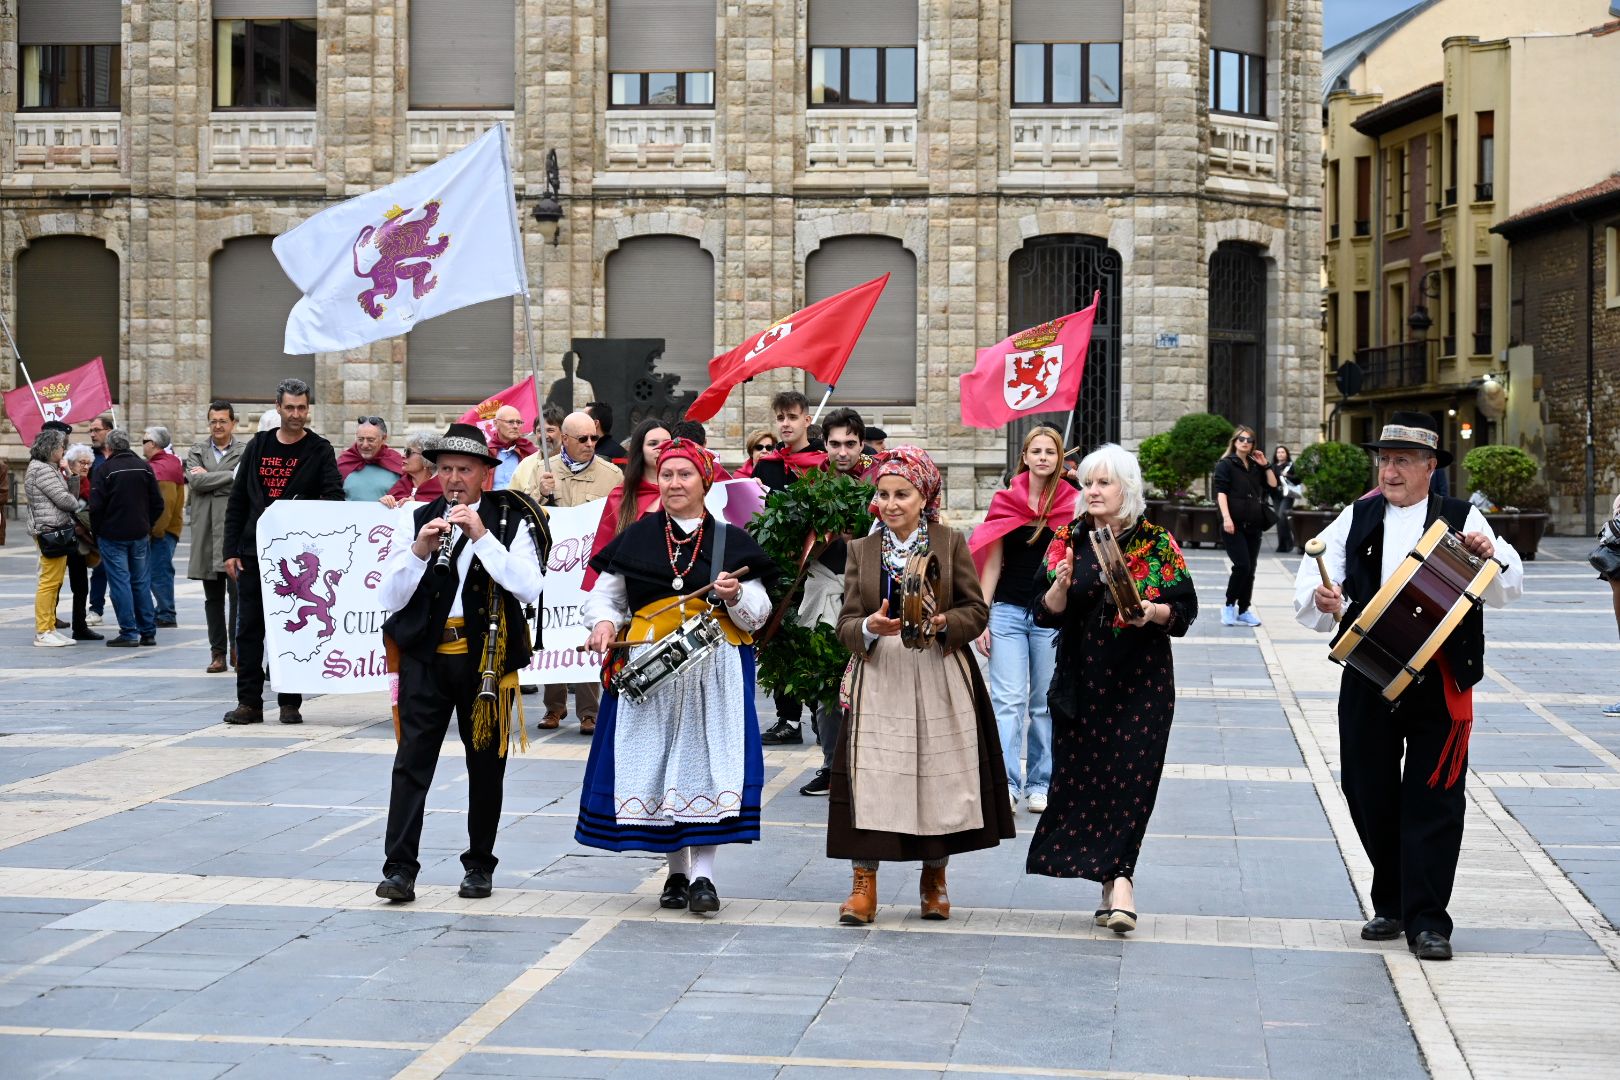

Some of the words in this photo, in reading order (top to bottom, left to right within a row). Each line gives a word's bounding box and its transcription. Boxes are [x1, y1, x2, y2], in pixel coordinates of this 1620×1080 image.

[261, 457, 282, 467] THE
[259, 467, 292, 477] ROCKE
[343, 610, 391, 634] CULT
[321, 648, 388, 679] Sala
